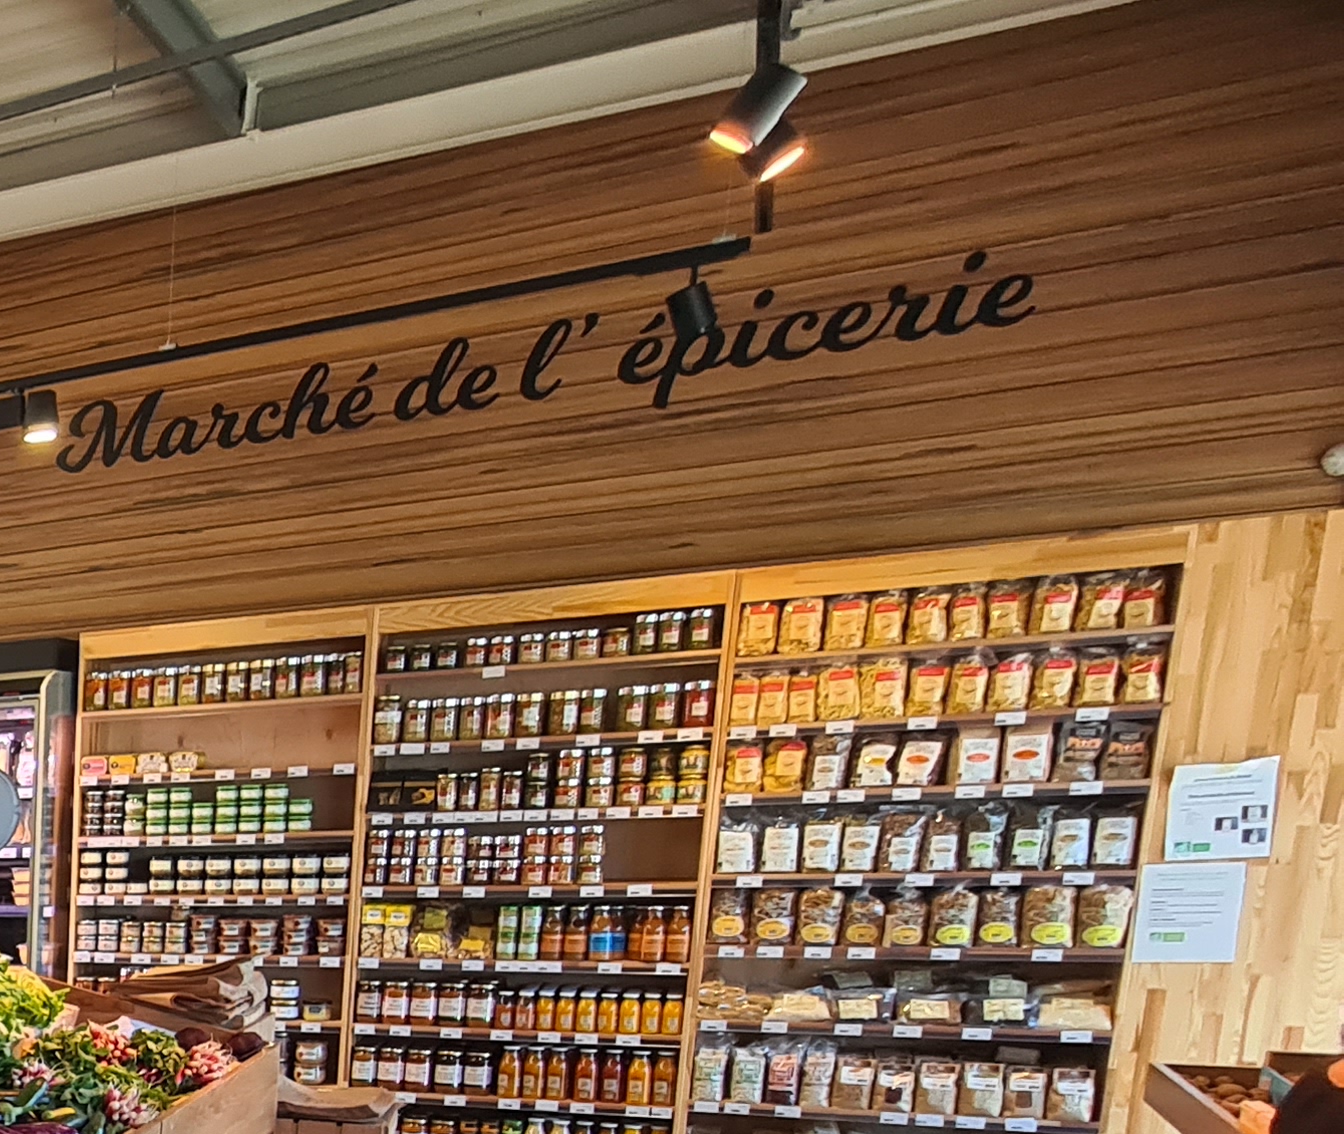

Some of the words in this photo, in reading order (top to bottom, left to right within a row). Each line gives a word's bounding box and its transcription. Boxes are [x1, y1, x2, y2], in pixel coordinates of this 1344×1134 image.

[54, 358, 378, 474] Marché
[393, 335, 498, 420] de
[617, 250, 1037, 409] épicerie
